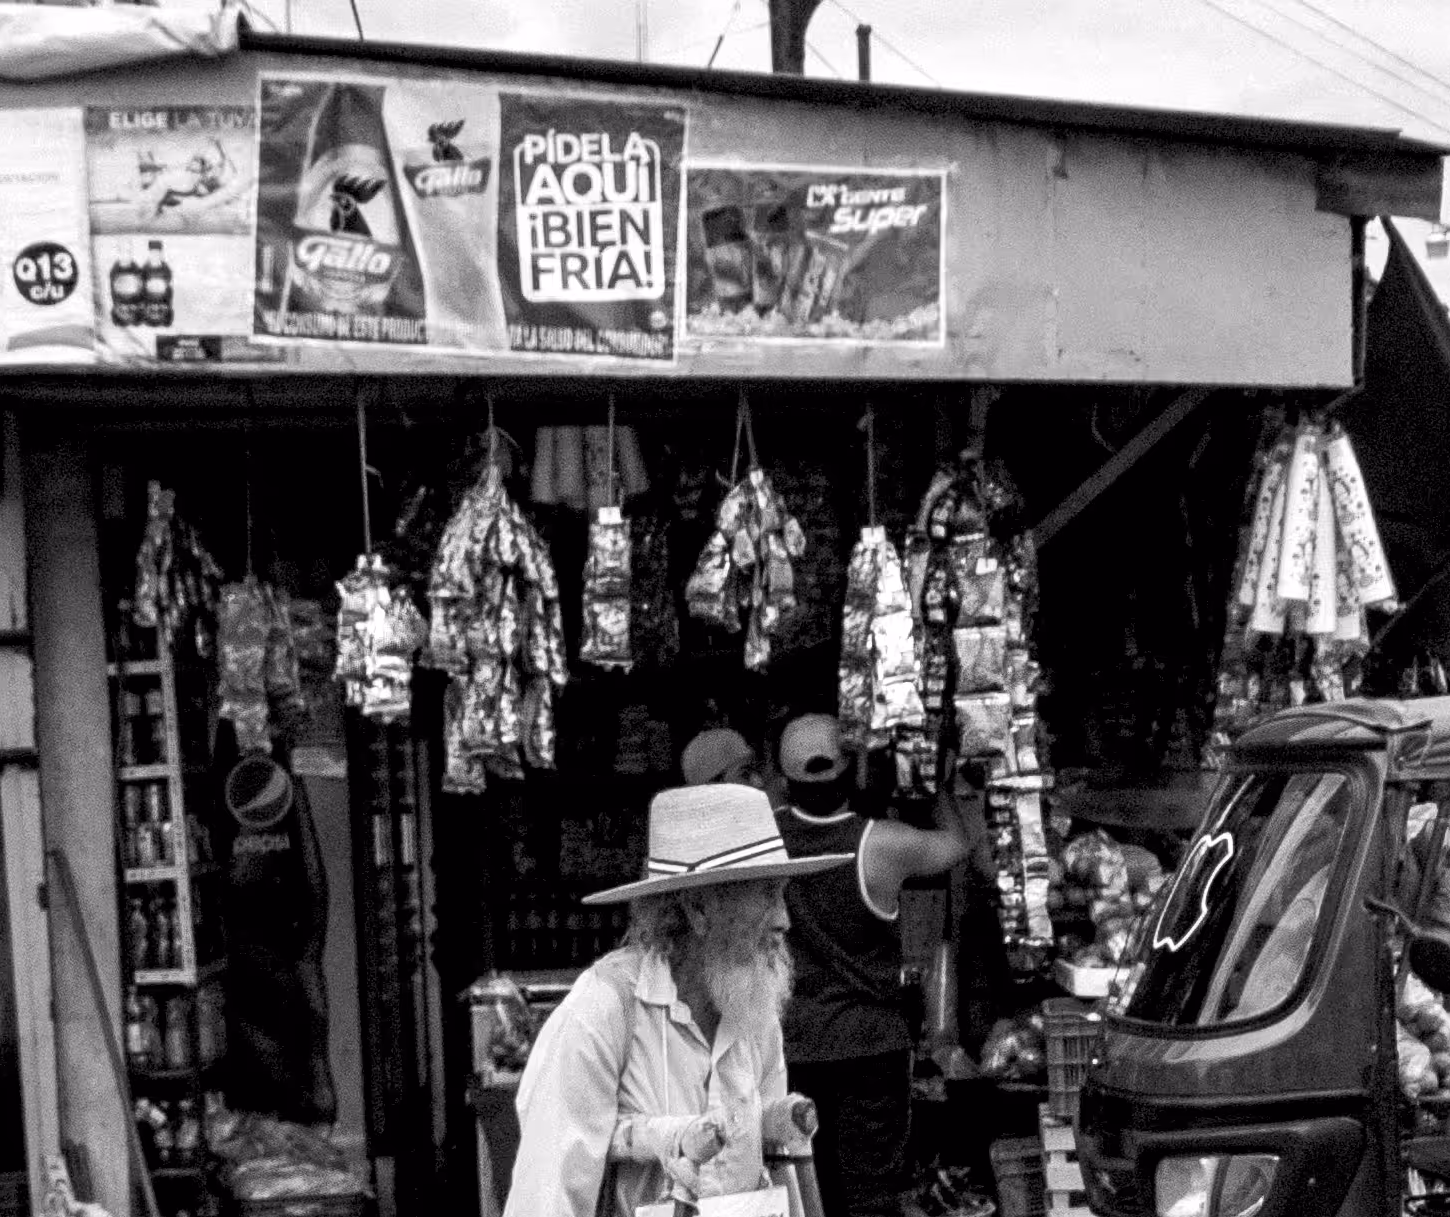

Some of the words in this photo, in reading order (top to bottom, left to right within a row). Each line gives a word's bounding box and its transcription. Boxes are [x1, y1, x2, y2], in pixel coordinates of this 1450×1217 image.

[109, 111, 167, 129] ELIGE
[523, 127, 651, 165] PÍDELA
[414, 166, 482, 195] Gallo
[15, 252, 74, 282] Q13
[297, 235, 391, 274] Gallo
